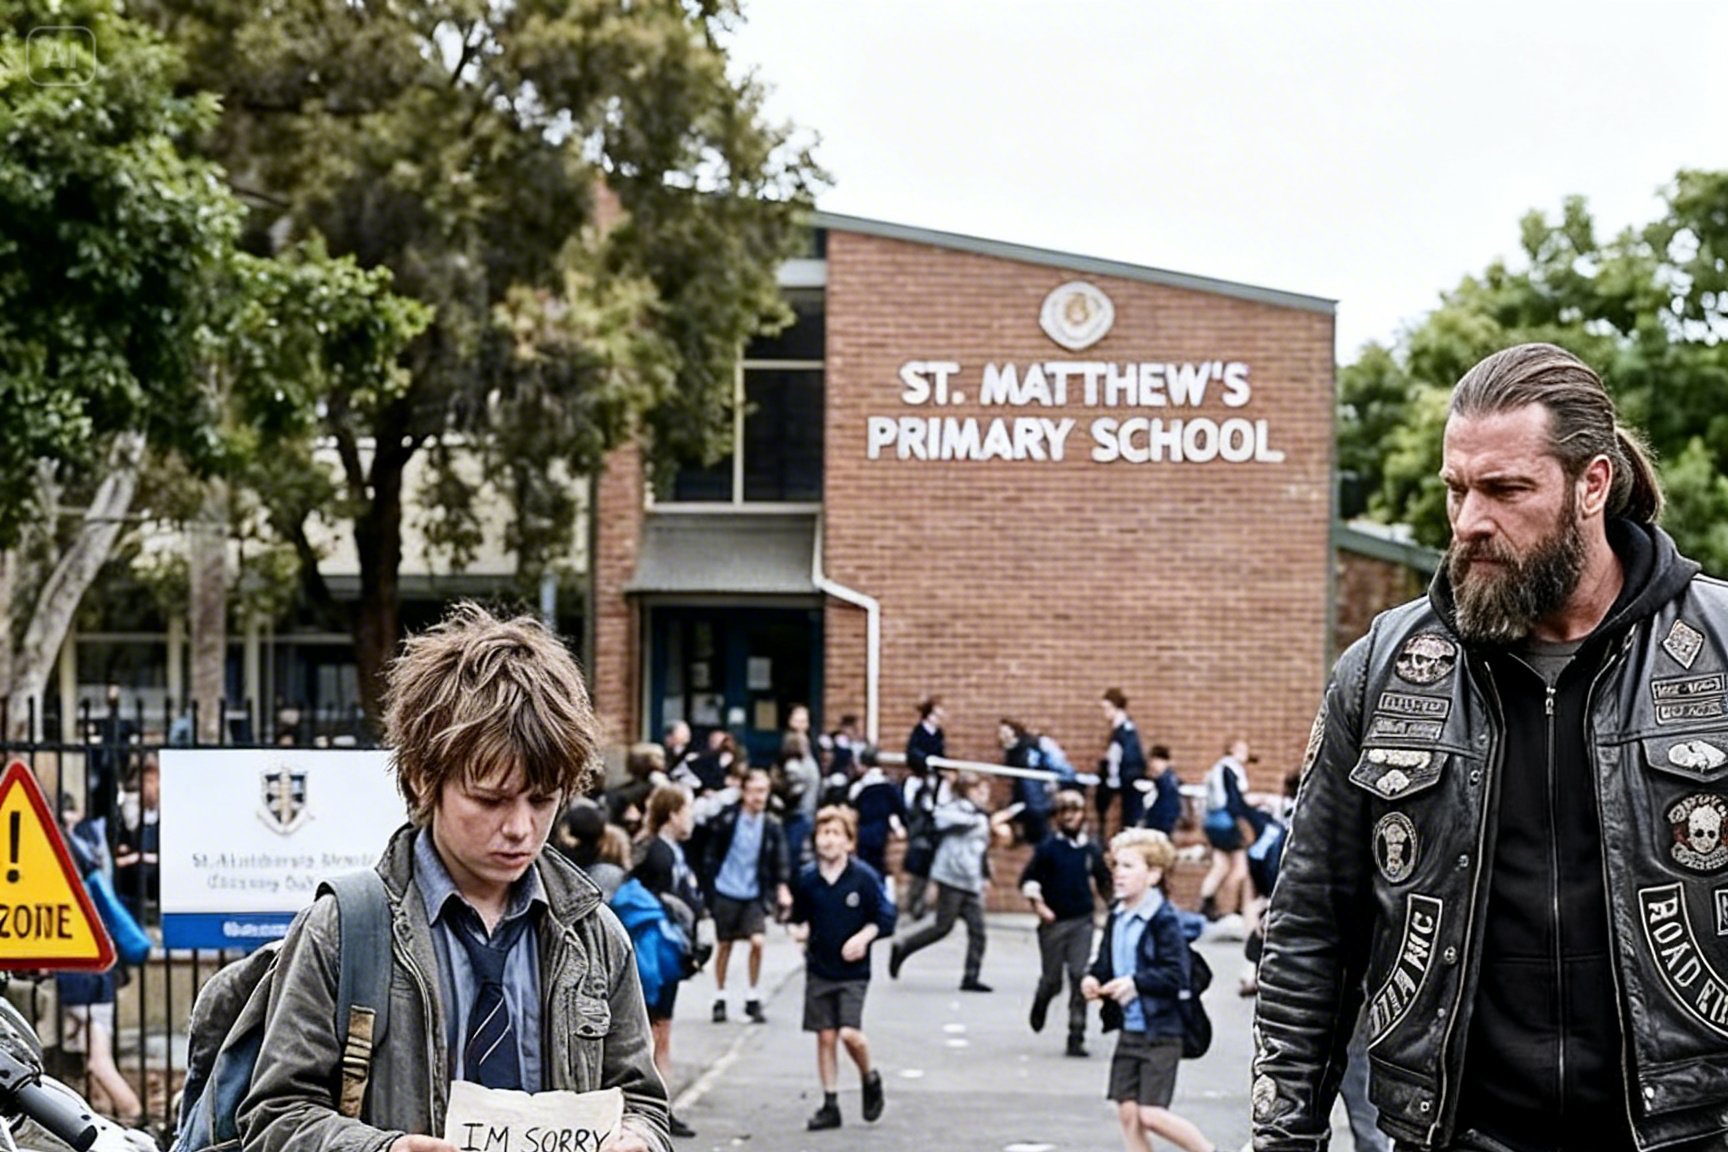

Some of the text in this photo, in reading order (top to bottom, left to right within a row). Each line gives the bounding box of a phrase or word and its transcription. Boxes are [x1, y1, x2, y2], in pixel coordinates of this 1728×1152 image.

[899, 361, 1251, 407] ST. MATTHEW'S
[866, 416, 1286, 463] PRIMARY SCHOOL
[1403, 911, 1434, 972] MC
[1648, 896, 1701, 987] ROAD
